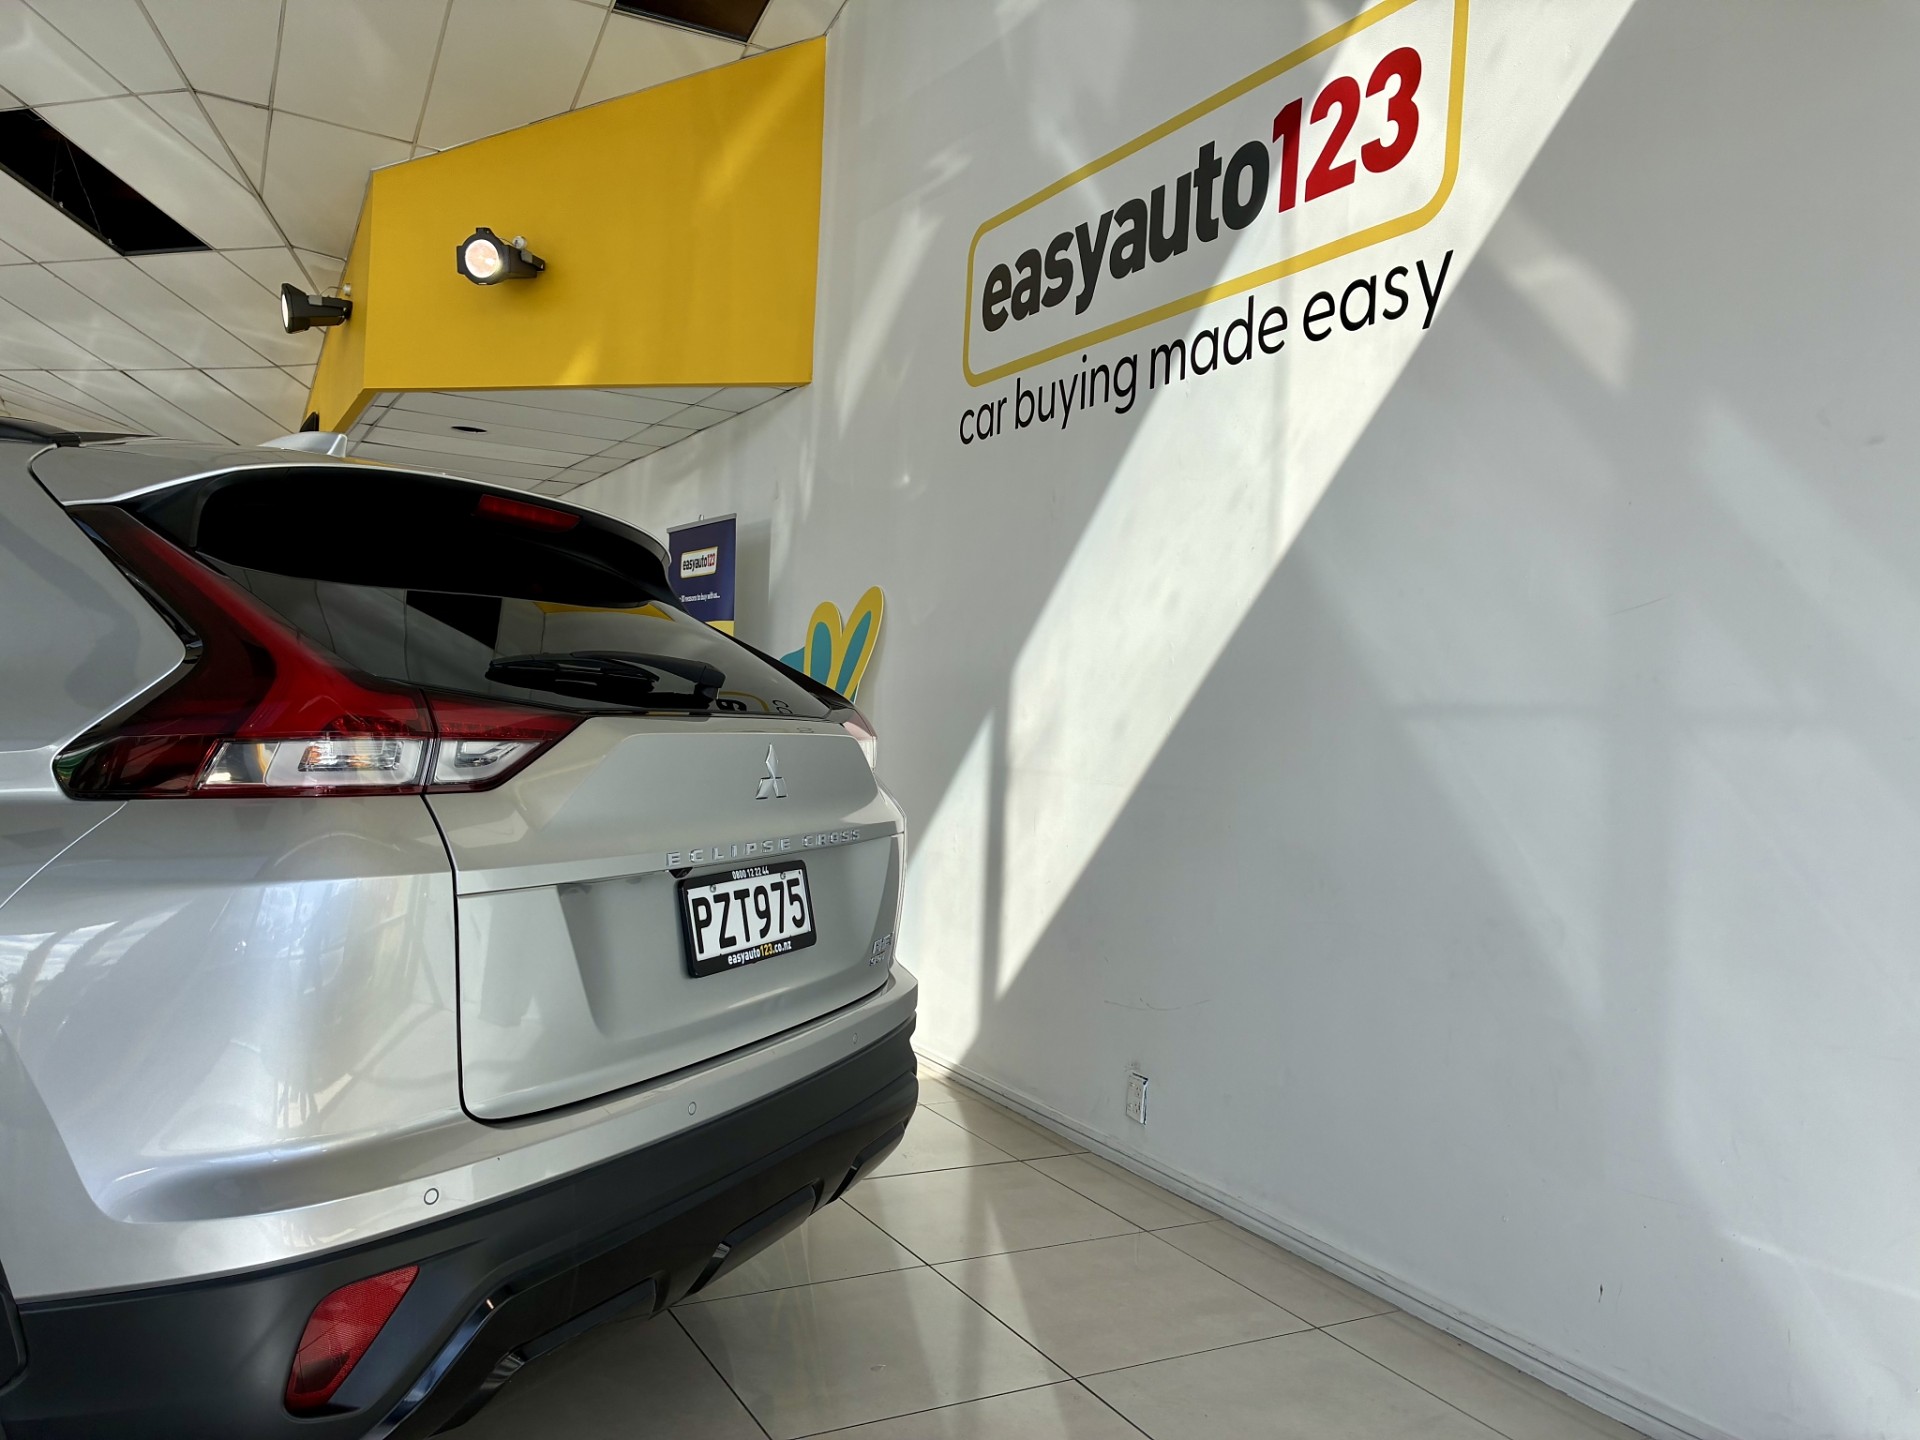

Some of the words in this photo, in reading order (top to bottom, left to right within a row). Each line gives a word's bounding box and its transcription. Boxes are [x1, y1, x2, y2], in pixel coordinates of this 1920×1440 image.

[982, 46, 1422, 332] easyauto123
[959, 396, 1007, 445] car
[1014, 353, 1137, 430] buying
[1149, 296, 1288, 389] made
[1303, 250, 1454, 342] easy
[682, 553, 715, 571] easyauto123
[667, 837, 790, 866] ECLIPSE
[802, 829, 861, 848] CROSS
[732, 870, 747, 879] 0800
[747, 868, 755, 877] 12
[754, 867, 762, 876] 22
[762, 866, 769, 875] 44
[691, 878, 806, 954] PZT975
[728, 941, 792, 965] easyauto123.co.nz
